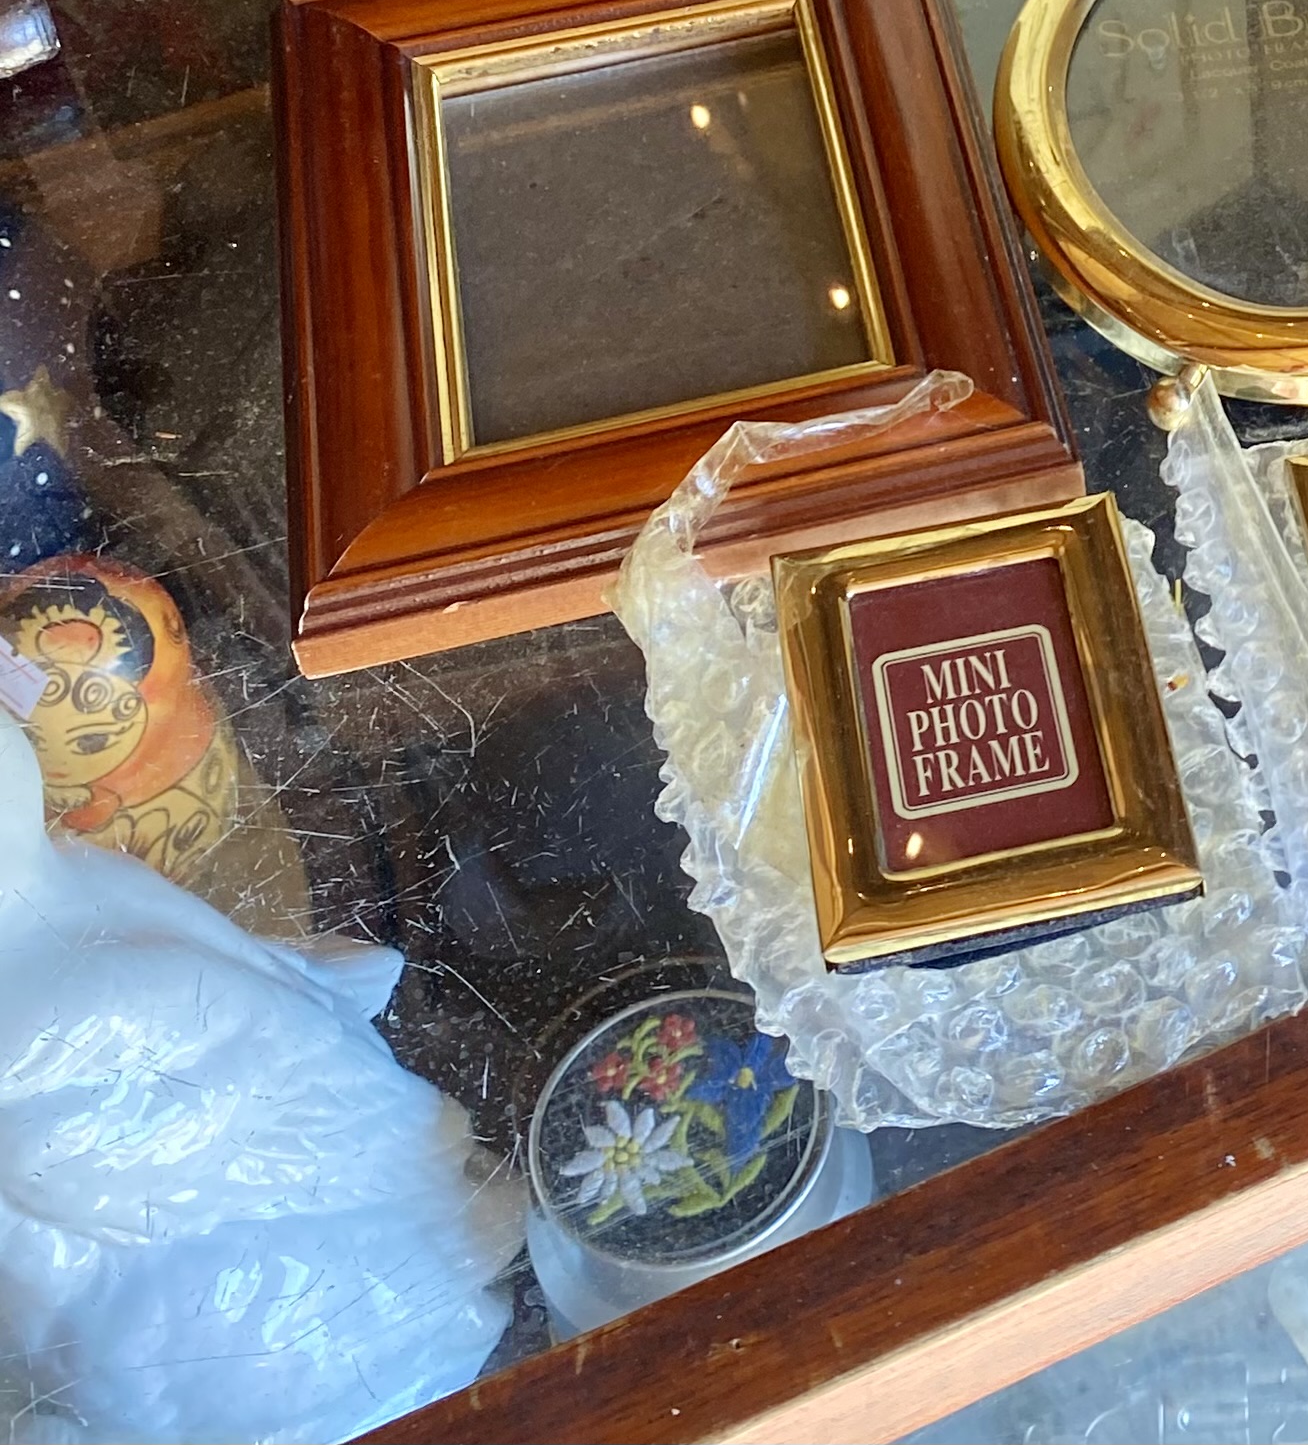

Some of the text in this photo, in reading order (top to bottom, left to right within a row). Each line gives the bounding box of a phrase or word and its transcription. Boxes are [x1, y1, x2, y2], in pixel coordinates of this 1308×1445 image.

[1098, 6, 1241, 58] Solid
[920, 650, 1011, 704] MINI
[906, 689, 1038, 752] PHOTO
[912, 730, 1049, 797] FRAME
